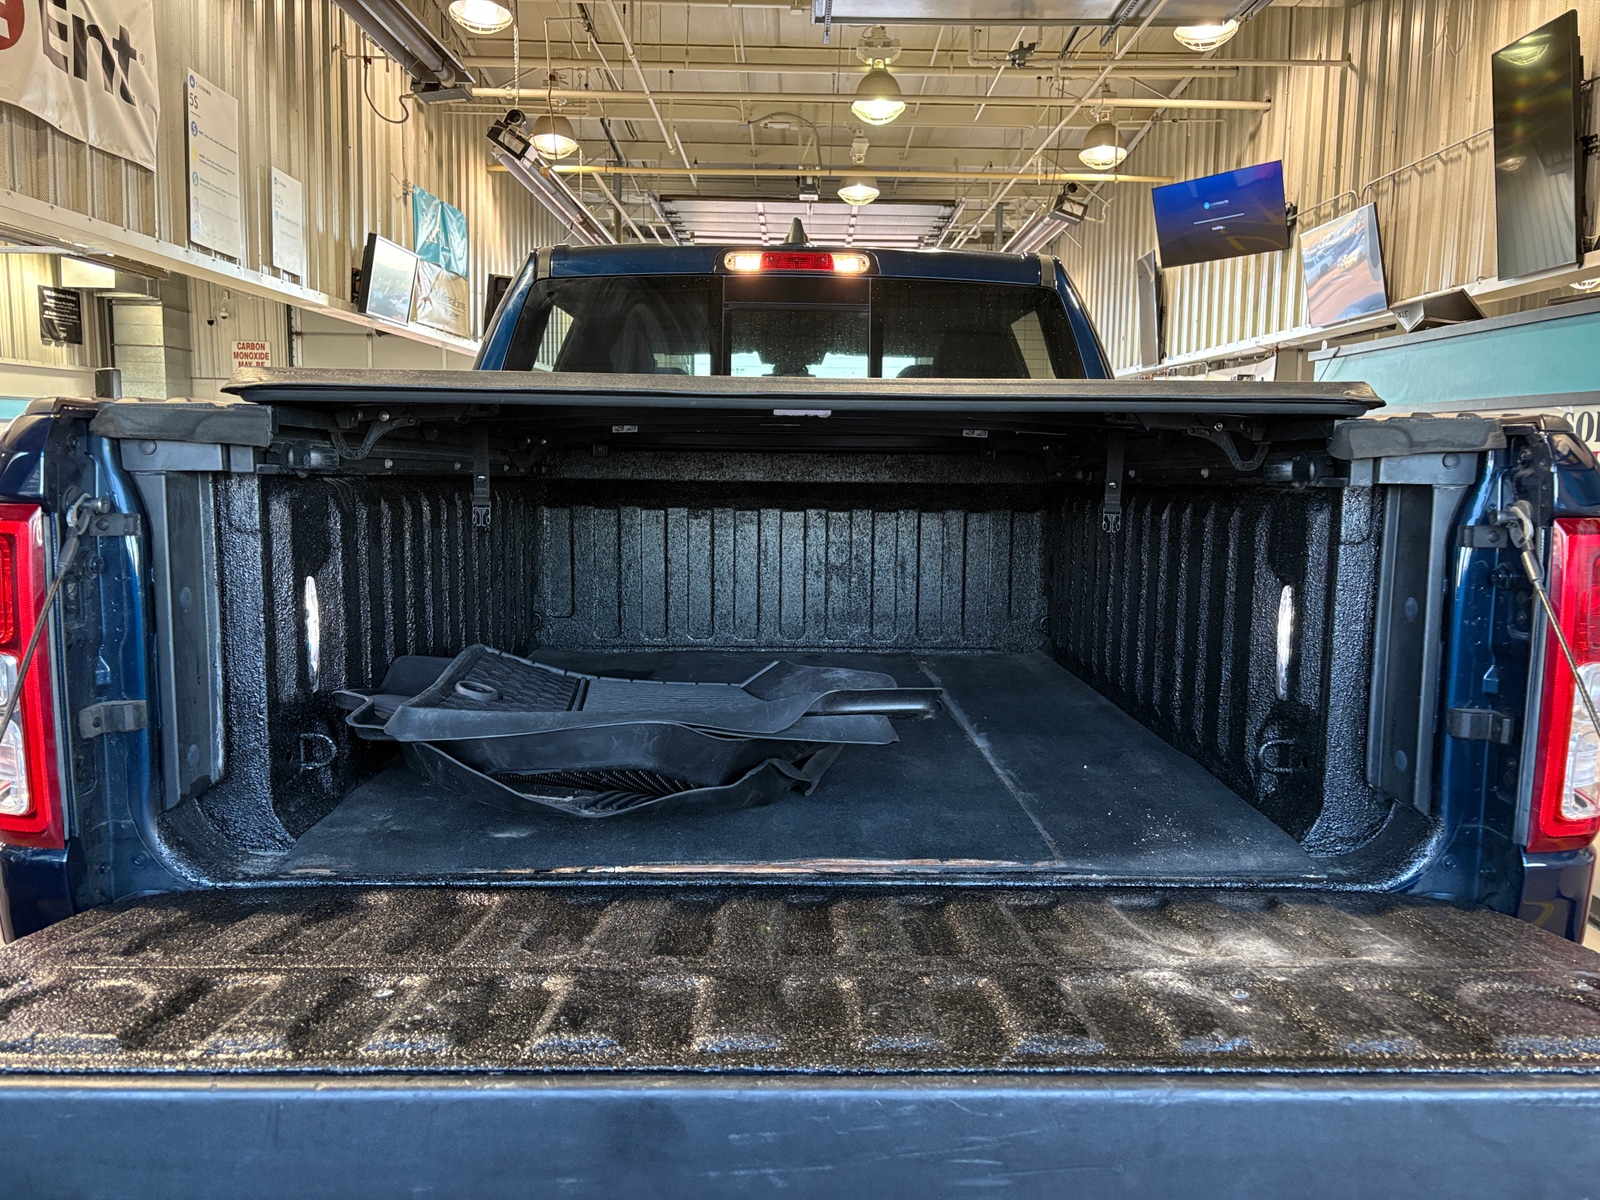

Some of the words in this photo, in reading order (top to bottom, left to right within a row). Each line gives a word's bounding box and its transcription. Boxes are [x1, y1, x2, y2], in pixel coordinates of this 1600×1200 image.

[189, 92, 199, 110] 5S
[236, 342, 265, 350] CARBON
[233, 351, 269, 360] MONOXIDE
